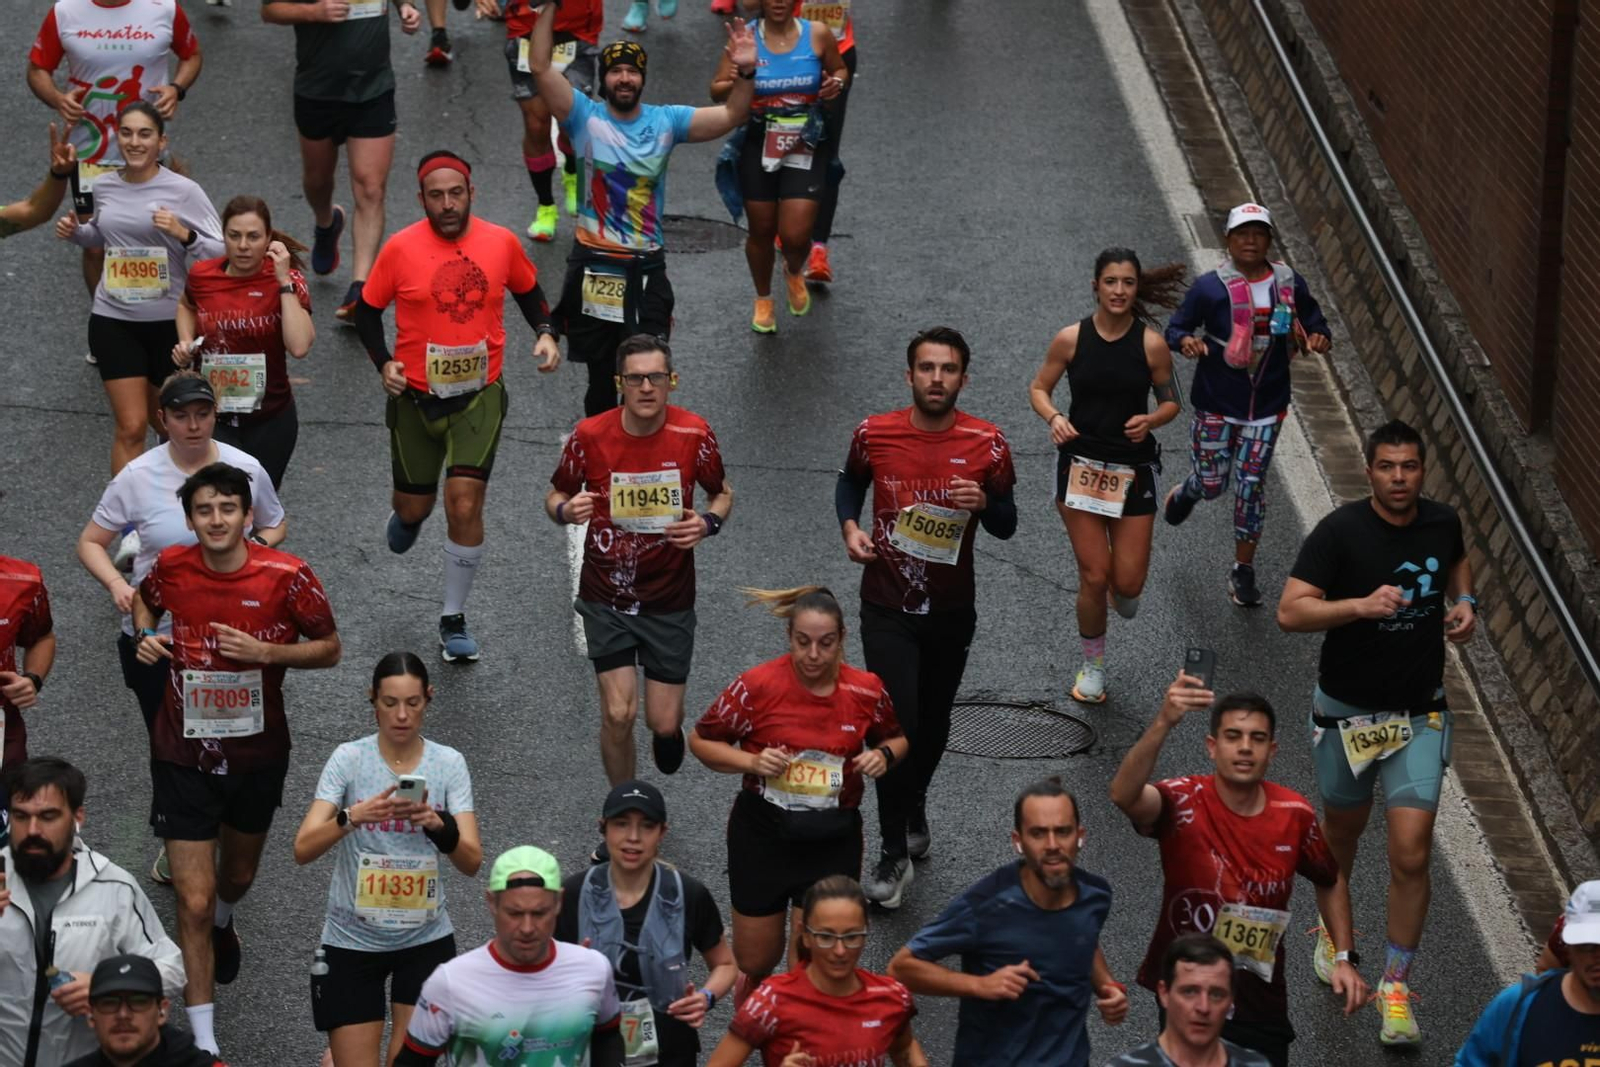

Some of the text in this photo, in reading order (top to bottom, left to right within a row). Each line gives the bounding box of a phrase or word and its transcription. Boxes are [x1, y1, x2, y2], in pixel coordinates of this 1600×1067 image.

[807, 5, 843, 20] 11149
[77, 24, 155, 40] maratón
[110, 261, 159, 278] 14396
[431, 356, 480, 375] 12537
[1079, 470, 1120, 492] 5769
[617, 487, 671, 508] 11943
[905, 511, 958, 540] 15085
[190, 687, 250, 709] 17809
[1350, 724, 1400, 753] 13307
[779, 761, 827, 785] 1371
[366, 873, 426, 897] 11331
